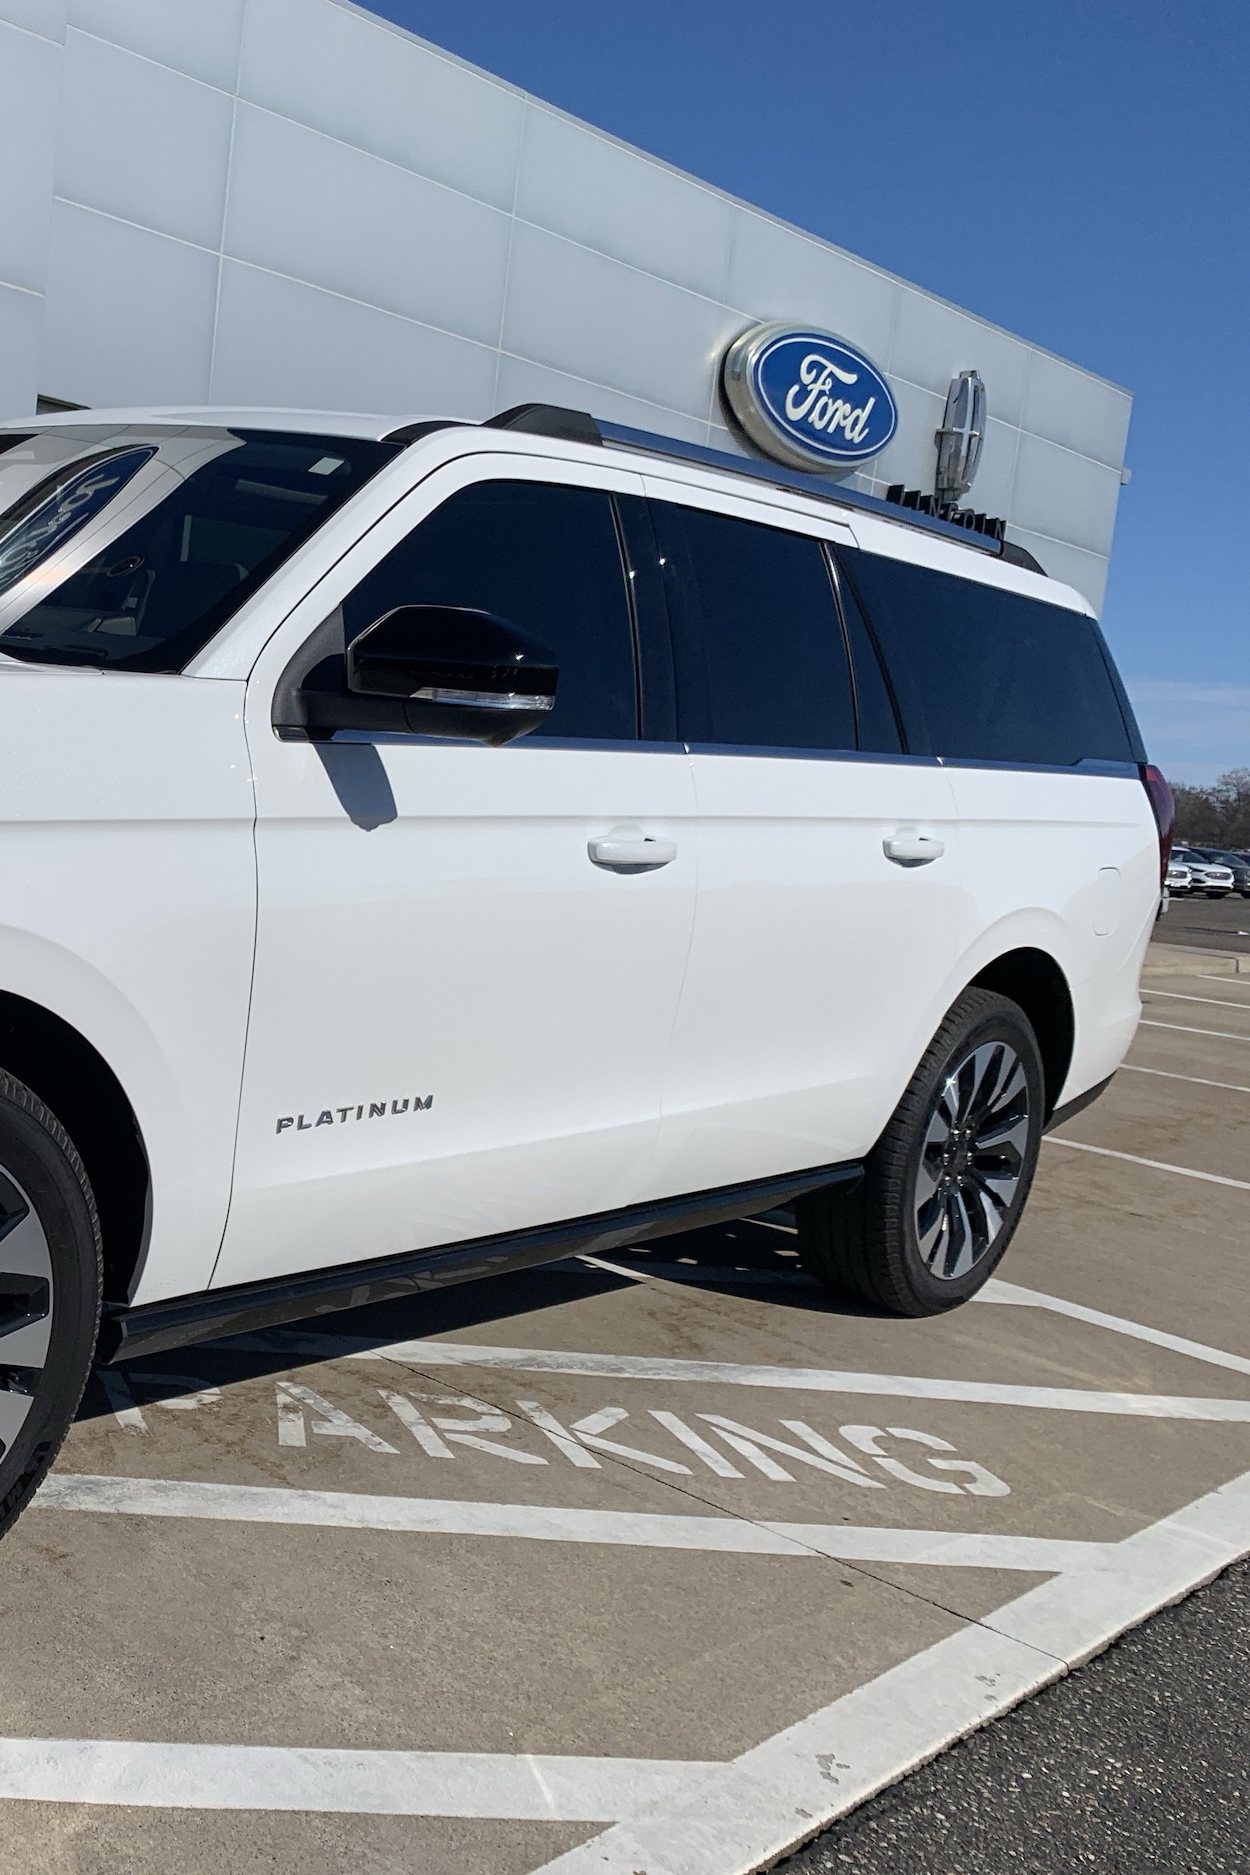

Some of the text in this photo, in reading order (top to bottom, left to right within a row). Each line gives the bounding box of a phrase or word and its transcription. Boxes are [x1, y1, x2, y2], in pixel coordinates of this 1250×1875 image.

[784, 353, 876, 444] Ford
[275, 1094, 434, 1135] PLATINUM
[95, 1370, 1011, 1498] PARKING
